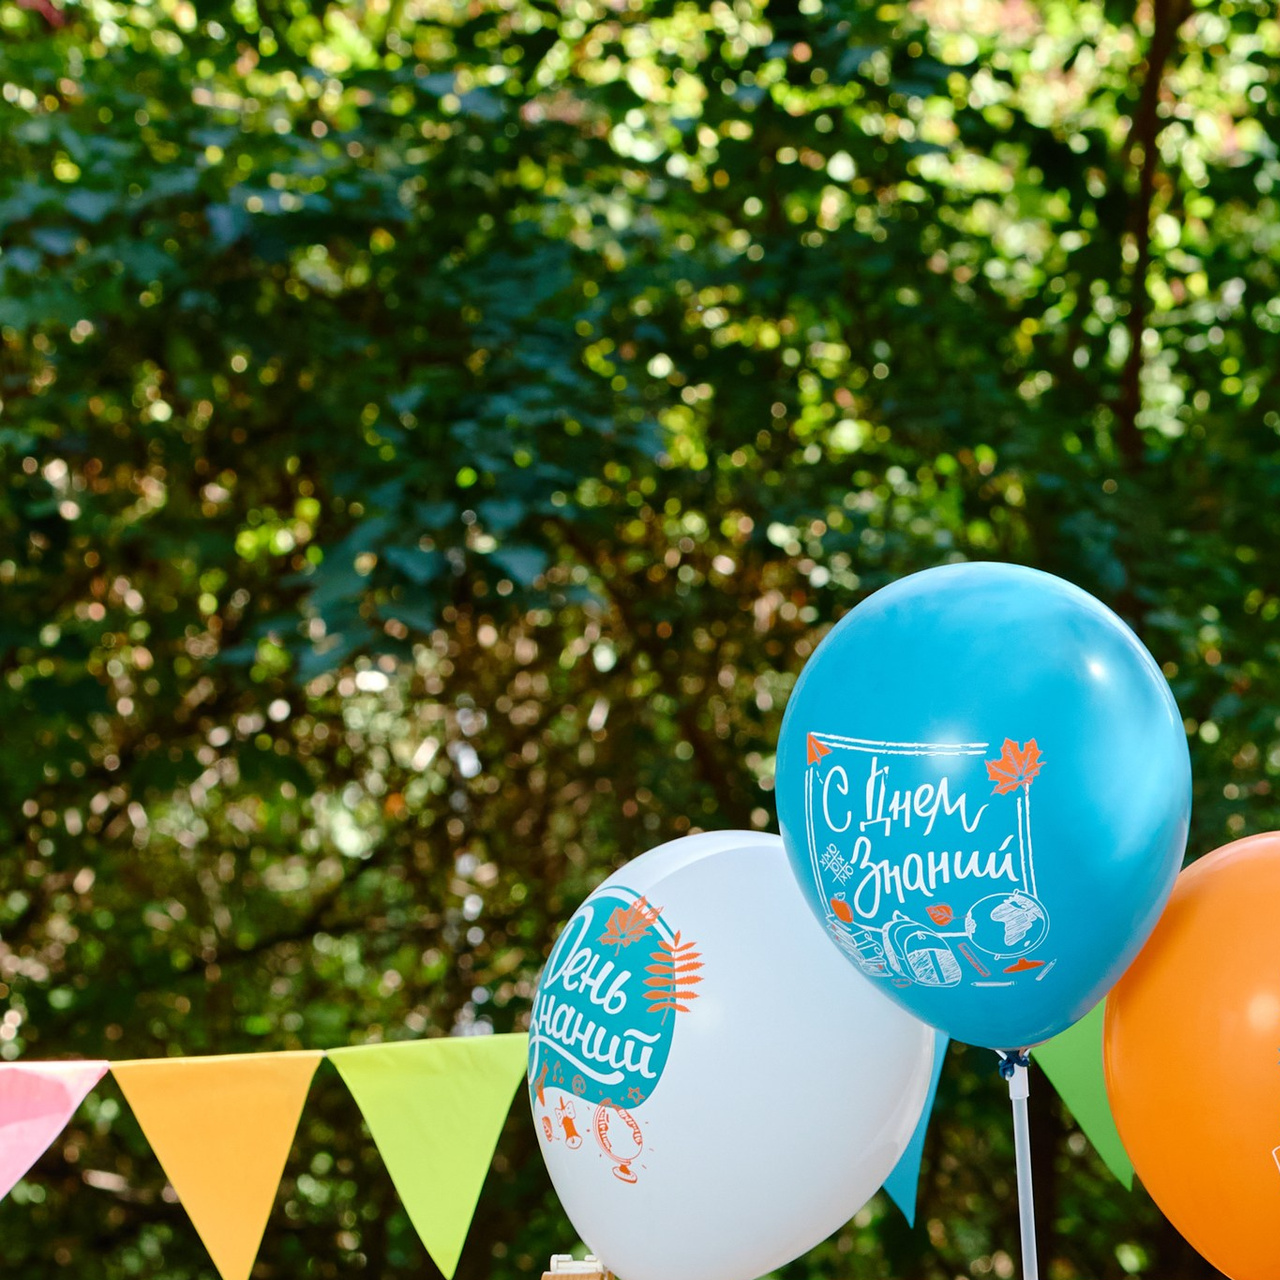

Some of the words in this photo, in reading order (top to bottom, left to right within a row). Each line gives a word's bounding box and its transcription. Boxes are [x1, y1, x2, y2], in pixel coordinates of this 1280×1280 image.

[822, 765, 852, 833] С
[860, 756, 990, 836] Днем
[850, 834, 1019, 918] Знаний
[543, 905, 632, 1015] День
